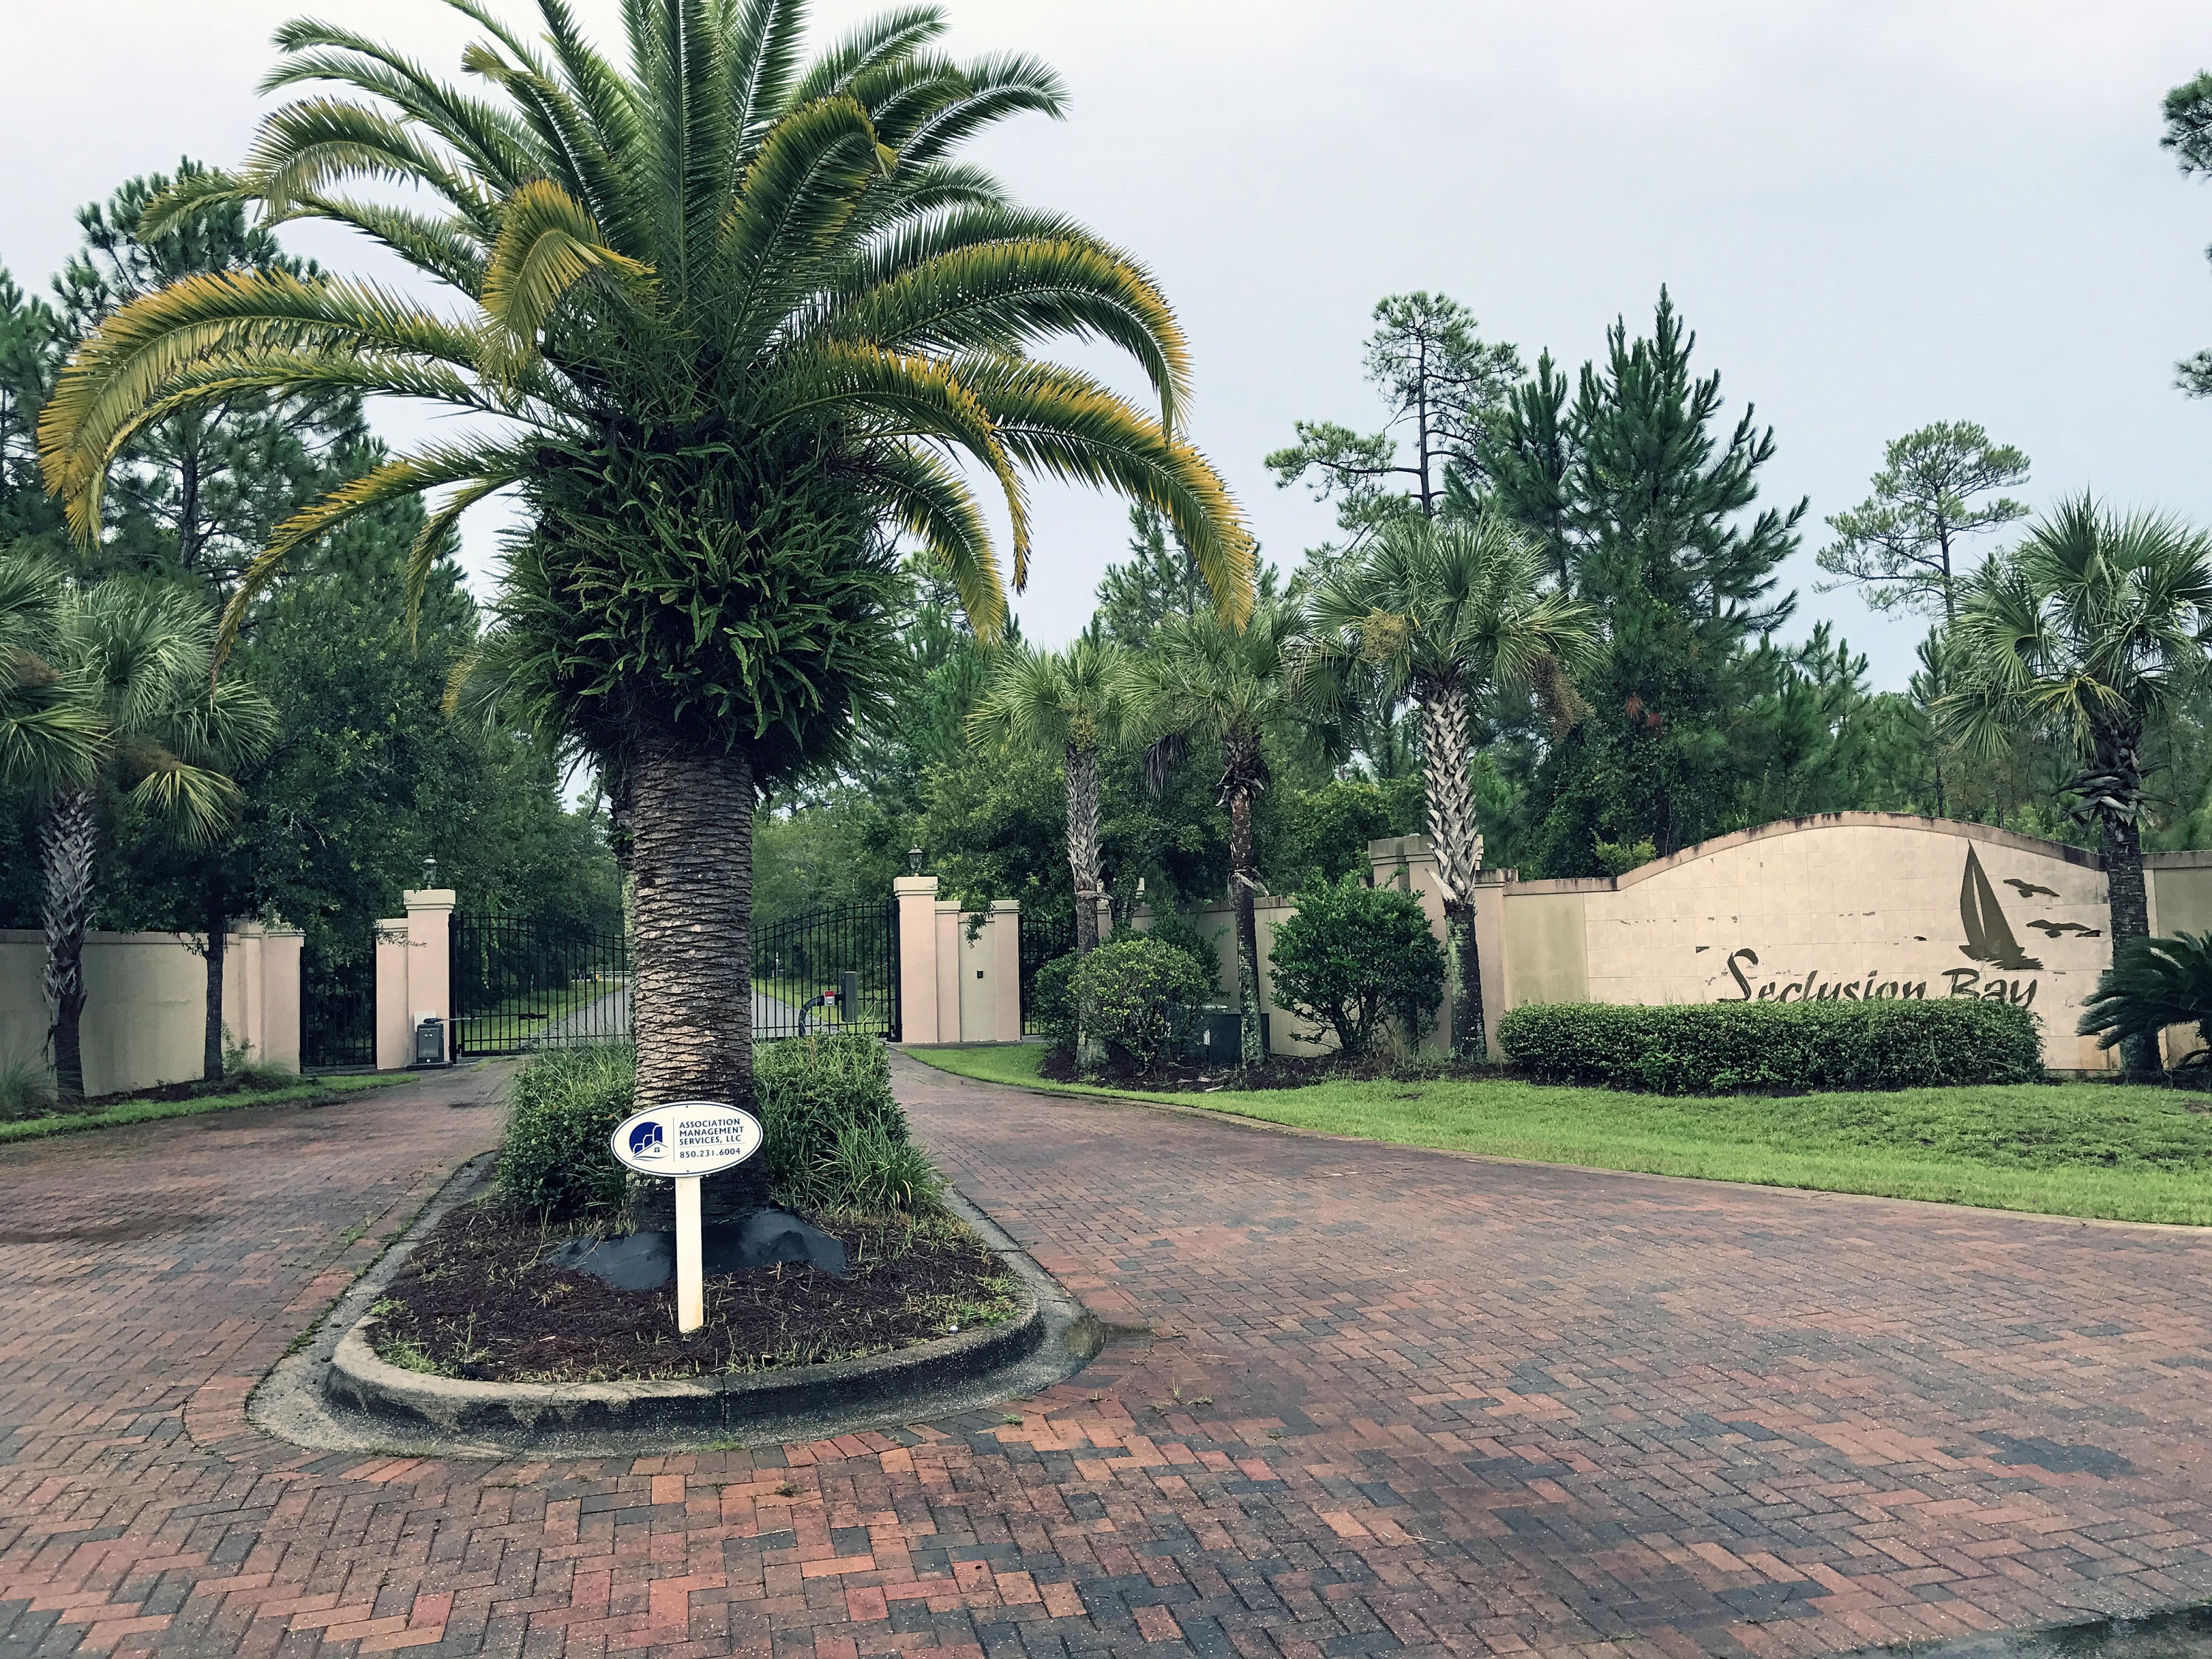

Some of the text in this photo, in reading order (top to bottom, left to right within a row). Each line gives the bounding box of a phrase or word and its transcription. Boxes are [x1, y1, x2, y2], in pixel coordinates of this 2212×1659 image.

[1717, 948, 2037, 1009] Seclusion Bay
[680, 1118, 740, 1128] ASSOCIATION
[679, 1126, 744, 1137] MANAGEMENT
[680, 1134, 742, 1145] SERVICES, LLC
[680, 1147, 741, 1158] 850.231.6004
